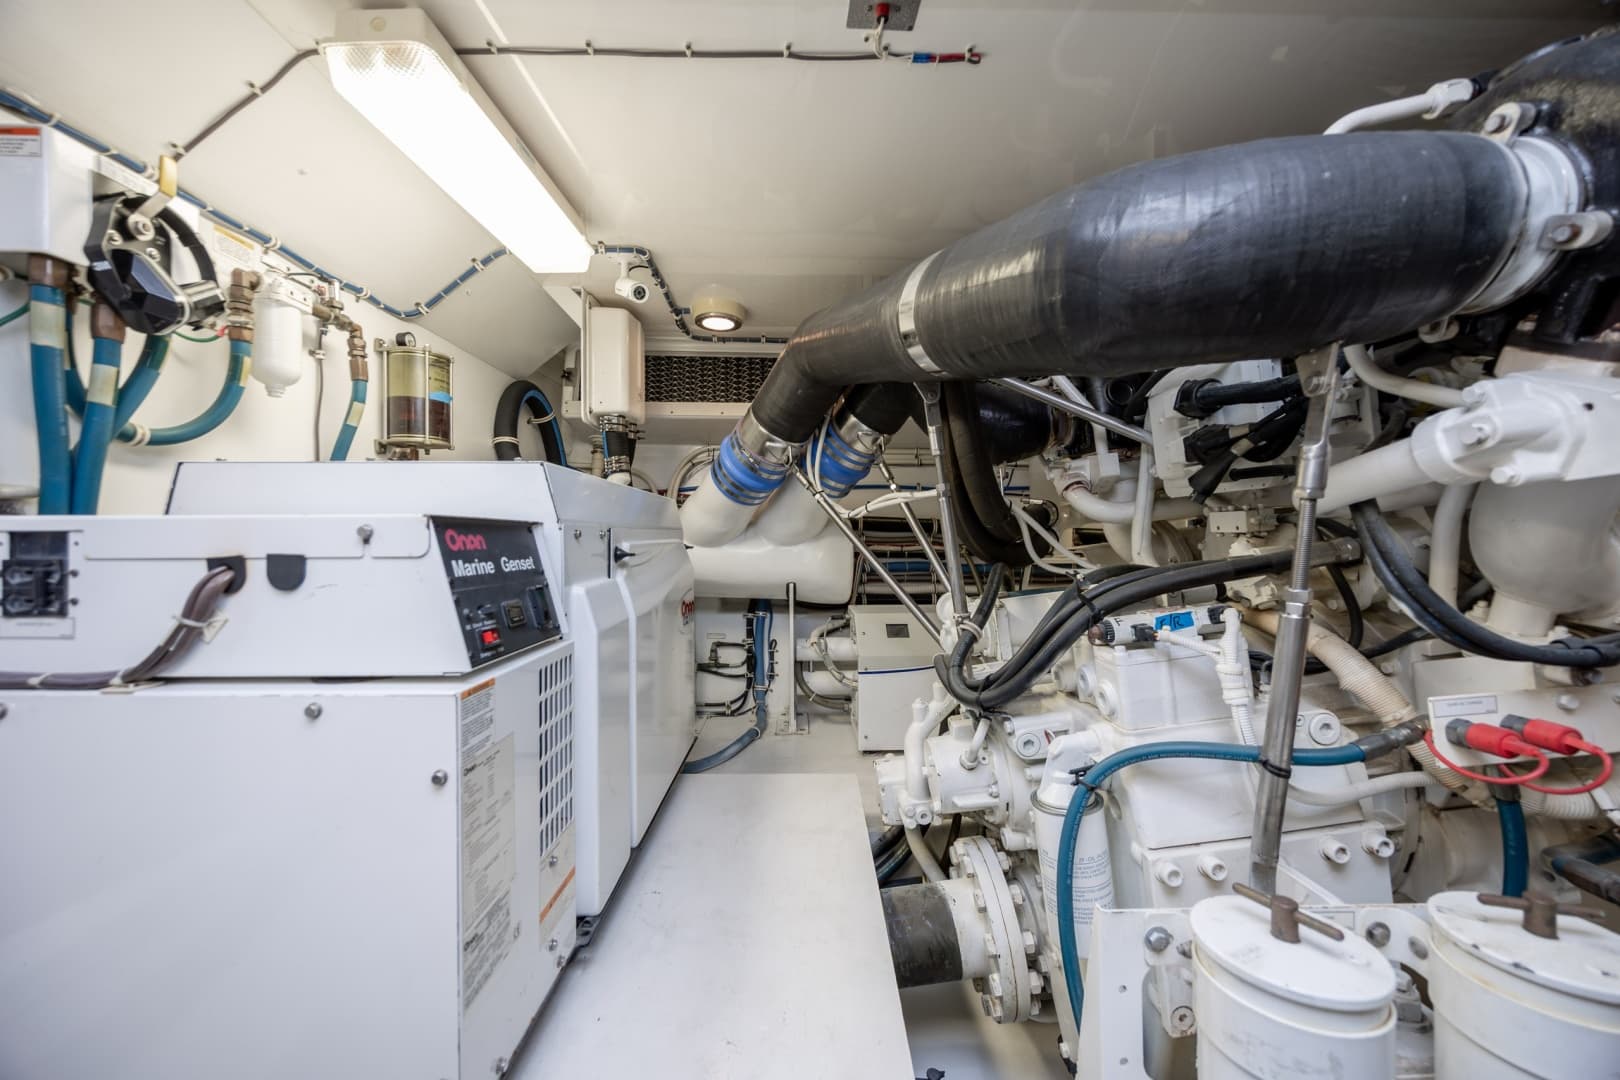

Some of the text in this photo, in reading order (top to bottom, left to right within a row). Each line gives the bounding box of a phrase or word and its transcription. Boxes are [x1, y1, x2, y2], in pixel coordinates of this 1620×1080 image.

[445, 529, 486, 551] Onan
[452, 556, 535, 577] Marine Genset
